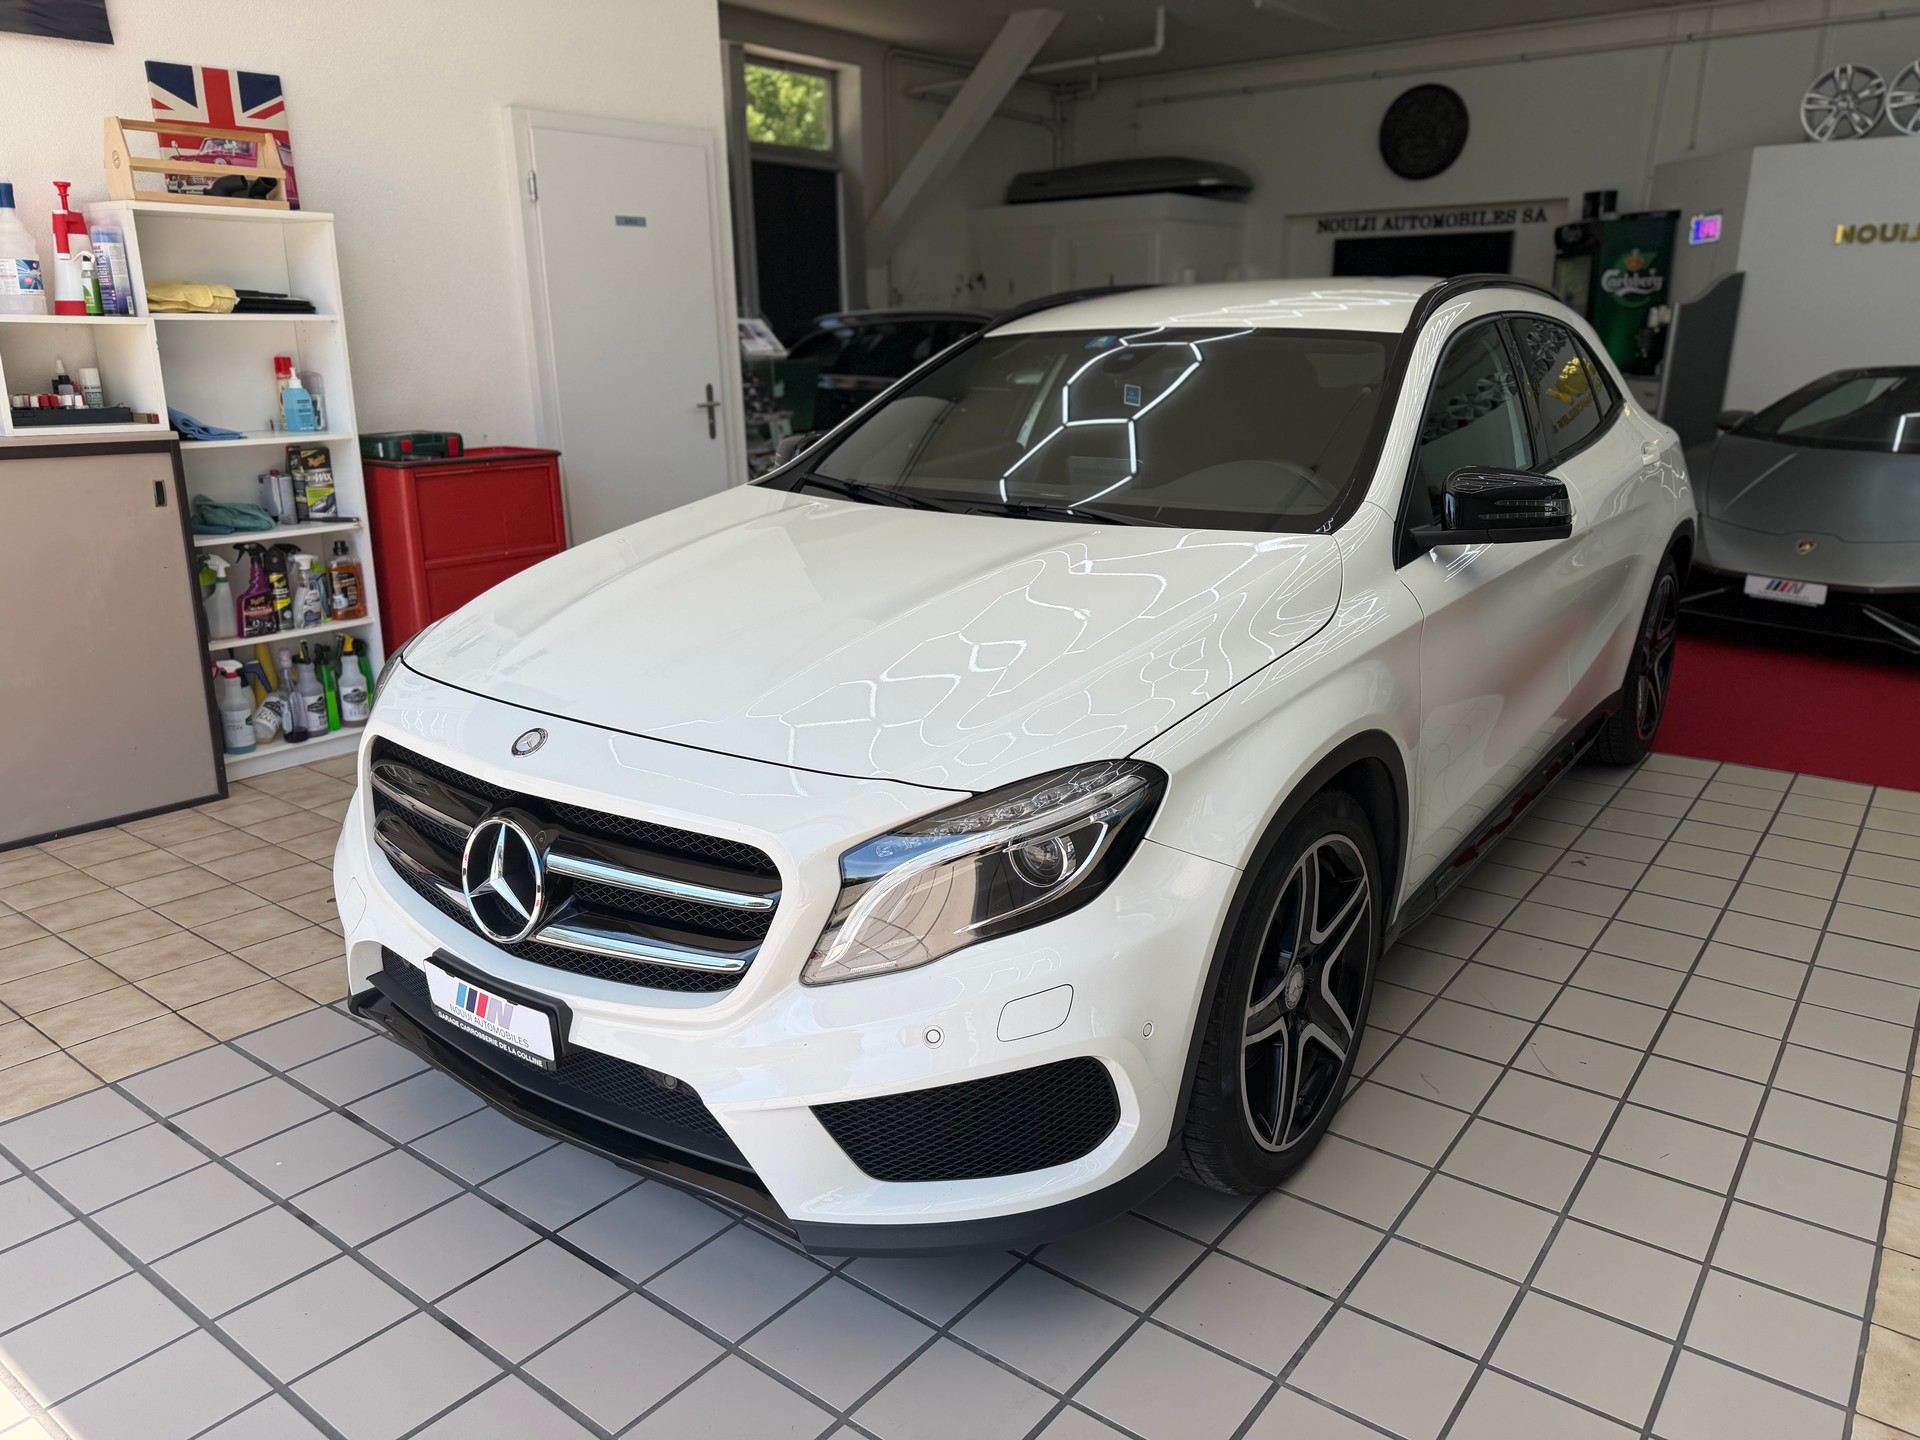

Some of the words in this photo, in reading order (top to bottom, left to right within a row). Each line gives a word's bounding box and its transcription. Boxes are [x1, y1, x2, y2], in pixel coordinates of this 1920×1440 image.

[1382, 209, 1517, 231] AUTOMOBILES
[1522, 207, 1548, 223] SA
[1601, 268, 1664, 297] Carlsberg
[437, 1011, 460, 1028] GARAGE
[459, 1022, 499, 1047] CARROSSERIE
[498, 1041, 508, 1051] DE
[507, 1046, 517, 1056] LA
[516, 1050, 544, 1068] COLLINE
[474, 1016, 530, 1048] AUTOMOBILES
